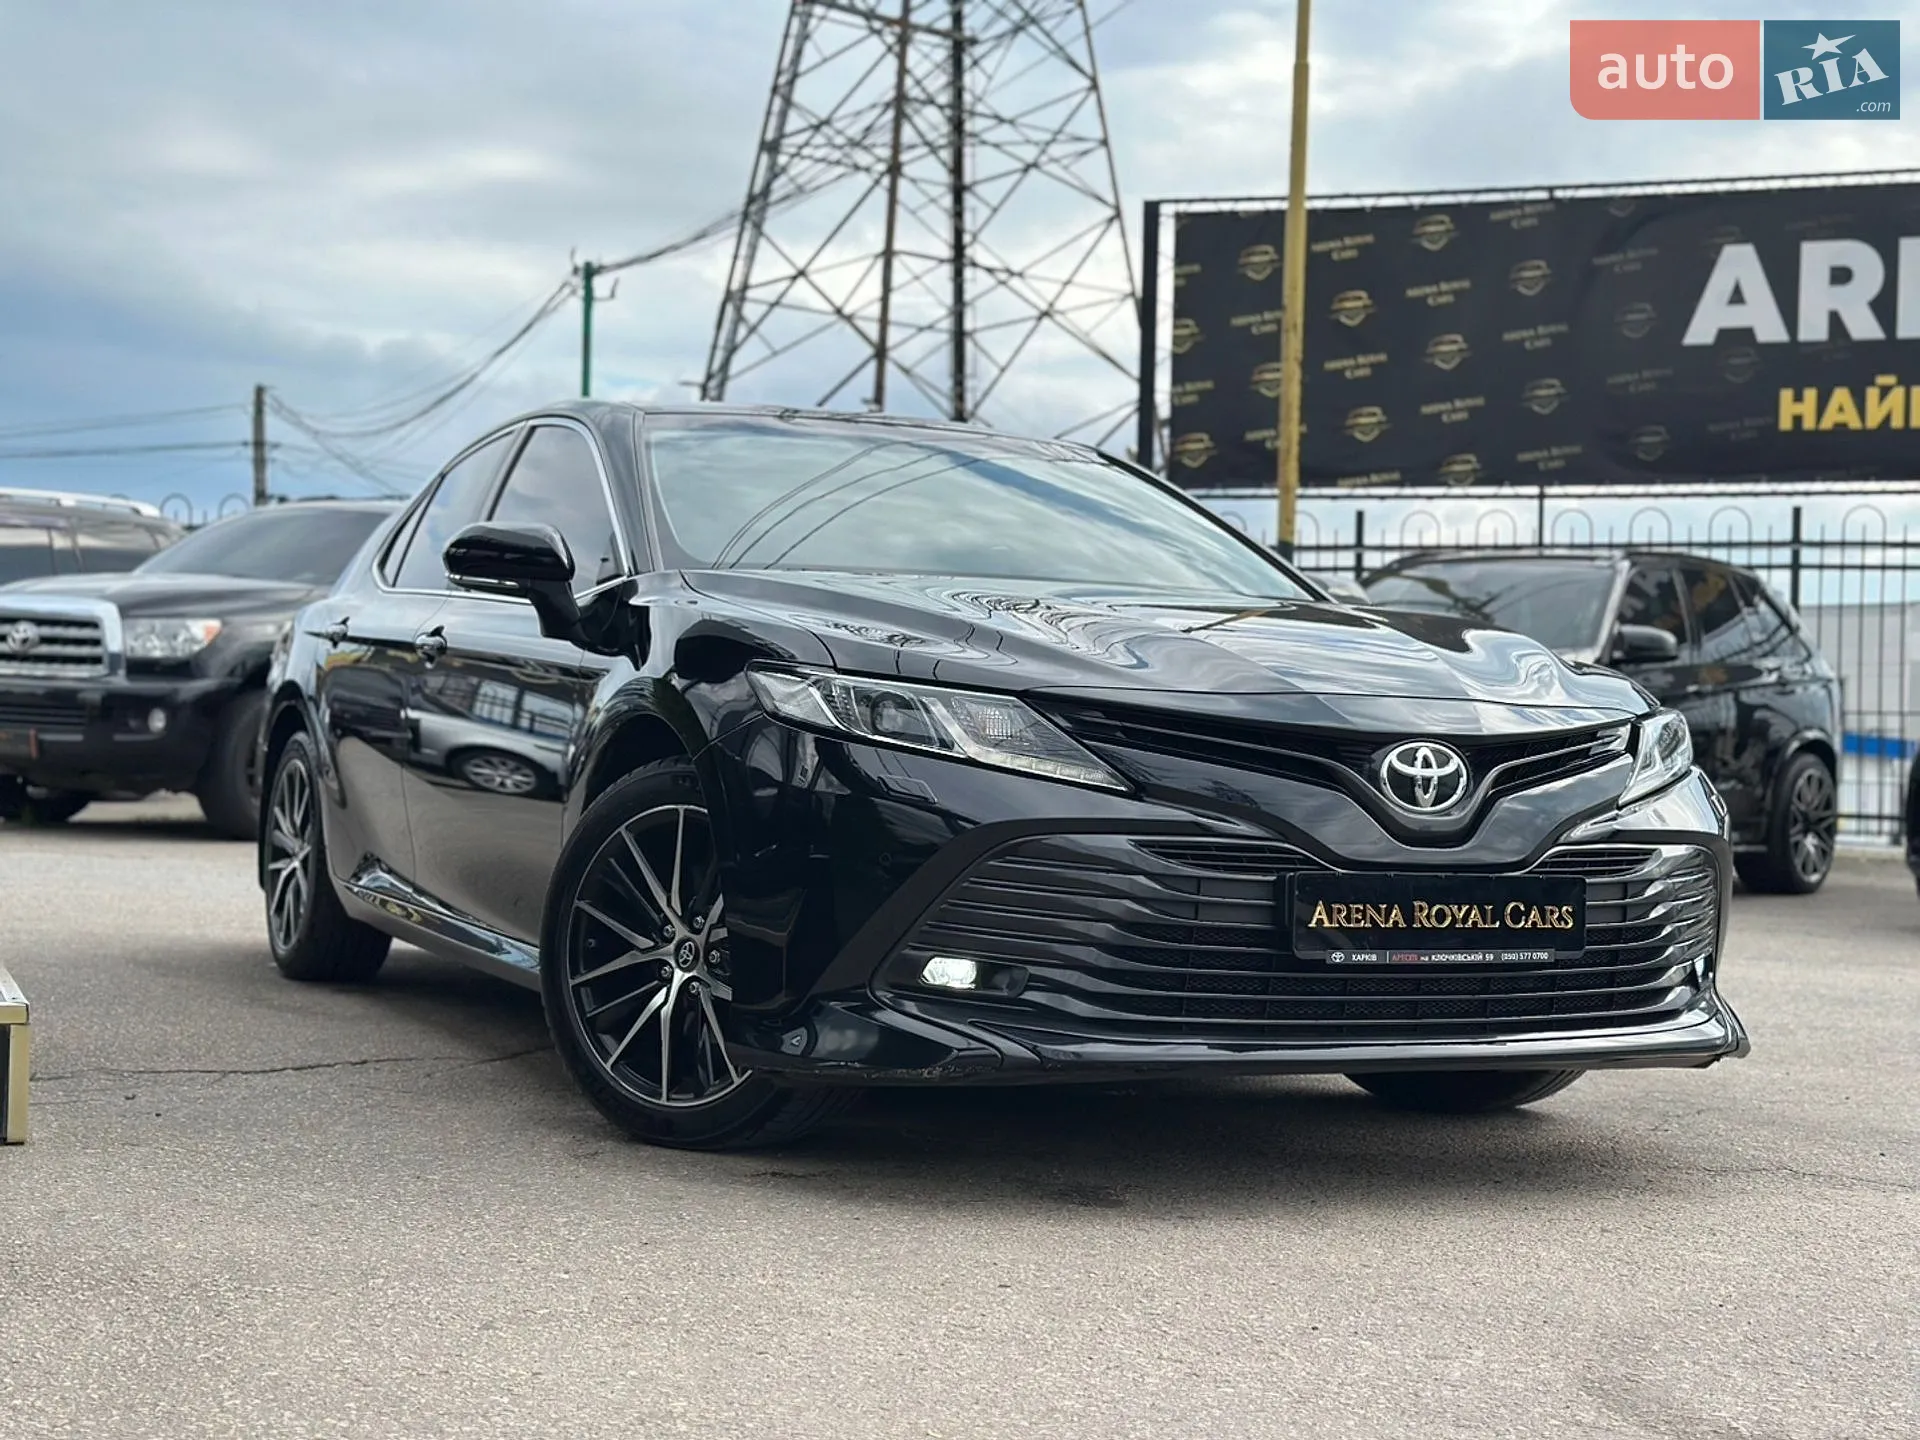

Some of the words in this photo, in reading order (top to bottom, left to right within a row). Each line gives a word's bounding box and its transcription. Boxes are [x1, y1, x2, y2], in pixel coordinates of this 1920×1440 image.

[1777, 373, 1920, 432] НАЙ
[1307, 900, 1407, 929] ARENA
[1412, 900, 1501, 929] ROYAL
[1503, 901, 1574, 929] CARS
